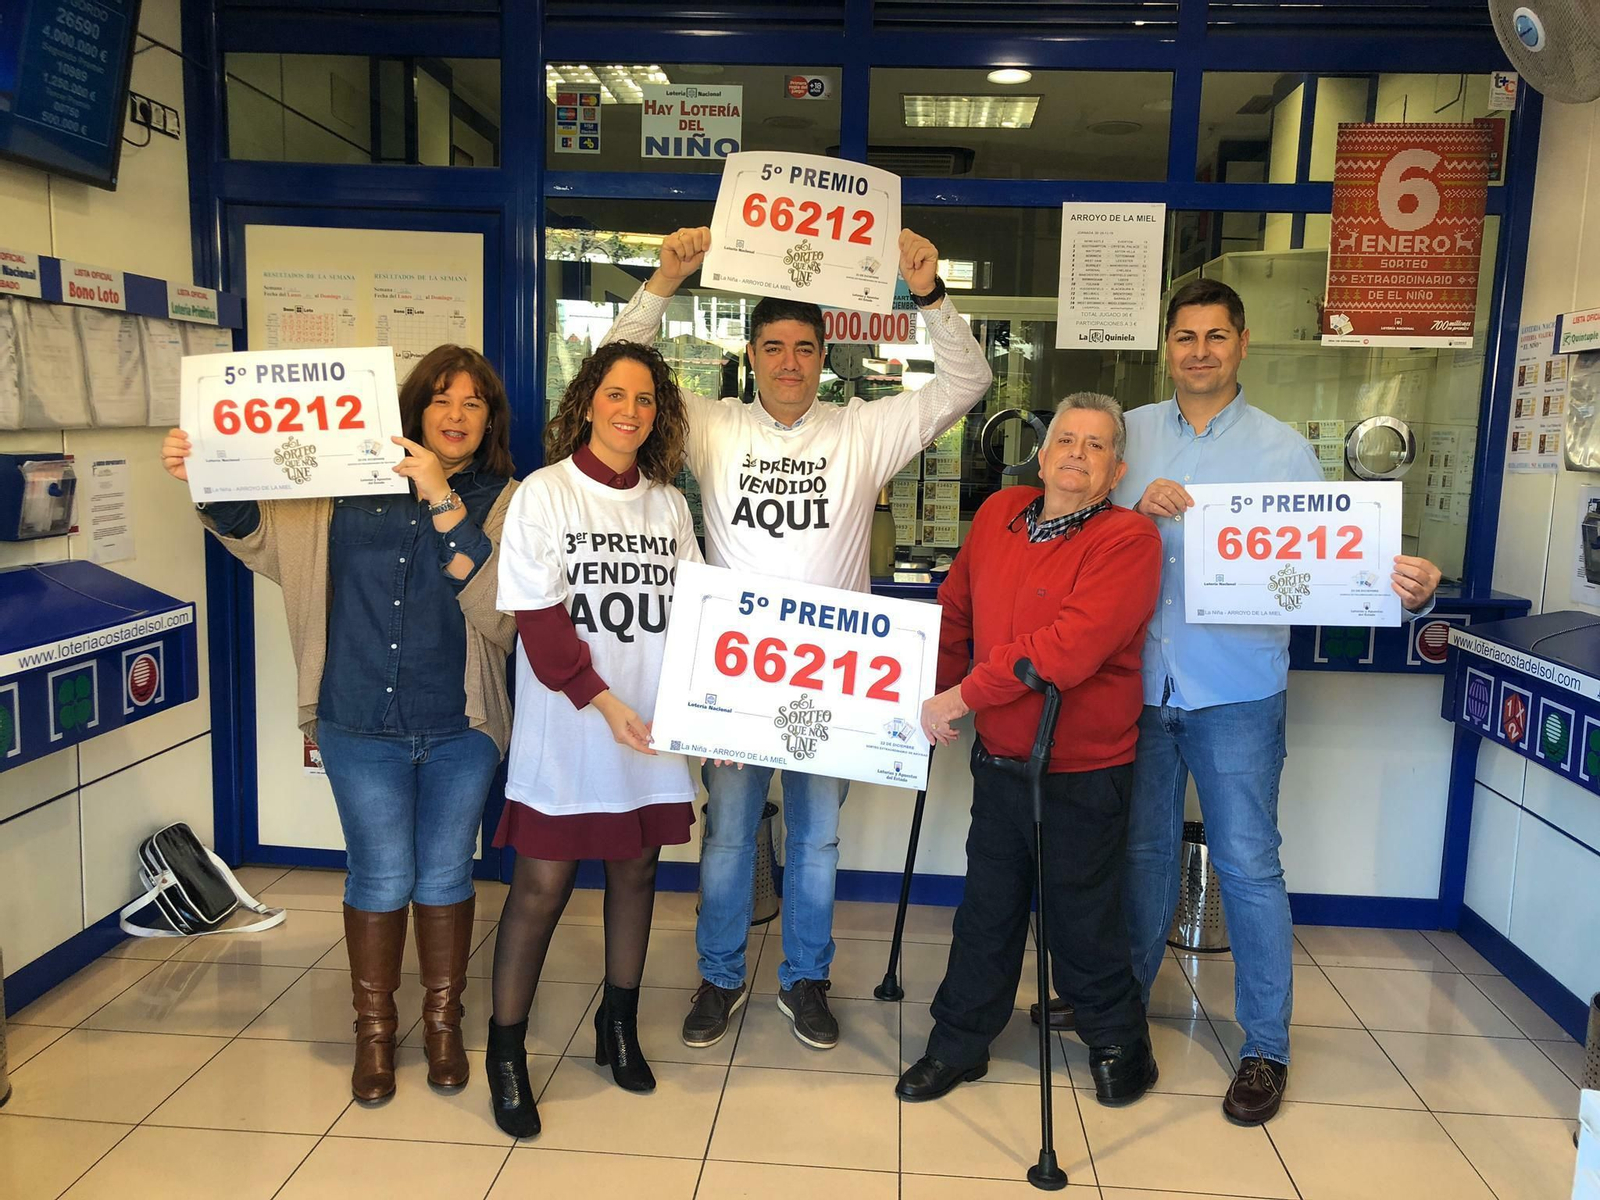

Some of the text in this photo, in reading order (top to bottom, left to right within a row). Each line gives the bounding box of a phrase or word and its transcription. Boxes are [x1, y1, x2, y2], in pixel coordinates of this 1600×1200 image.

[679, 120, 704, 131] DEL
[645, 133, 740, 157] NIÑO
[789, 166, 868, 196] PREMIO
[1377, 148, 1443, 231] 6
[742, 192, 875, 246] 66212
[1361, 234, 1450, 252] ENERO
[1380, 259, 1428, 269] SORTEO
[1350, 275, 1452, 285] EXTRAORDINARIO
[69, 281, 119, 304] Bono Loto
[1368, 289, 1433, 300] DE EL NIÑO
[1430, 320, 1449, 331] 700
[256, 362, 345, 384] PREMIO
[213, 395, 365, 435] 66212
[760, 457, 827, 475] PREMIO
[739, 473, 826, 495] VENDIDO
[1262, 494, 1350, 513] PREMIO
[731, 494, 829, 538] AQUÍ
[1218, 525, 1363, 560] 66212
[570, 592, 672, 643] AQU
[780, 598, 890, 638] PREMIO
[18, 610, 189, 670] www.loteriacostadelsol.com
[714, 630, 902, 703] 66212
[1453, 633, 1580, 691] www.loteriacostadelsol.com
[692, 744, 707, 752] Niña
[713, 748, 745, 758] ARROYO
[771, 756, 788, 765] MIEL
